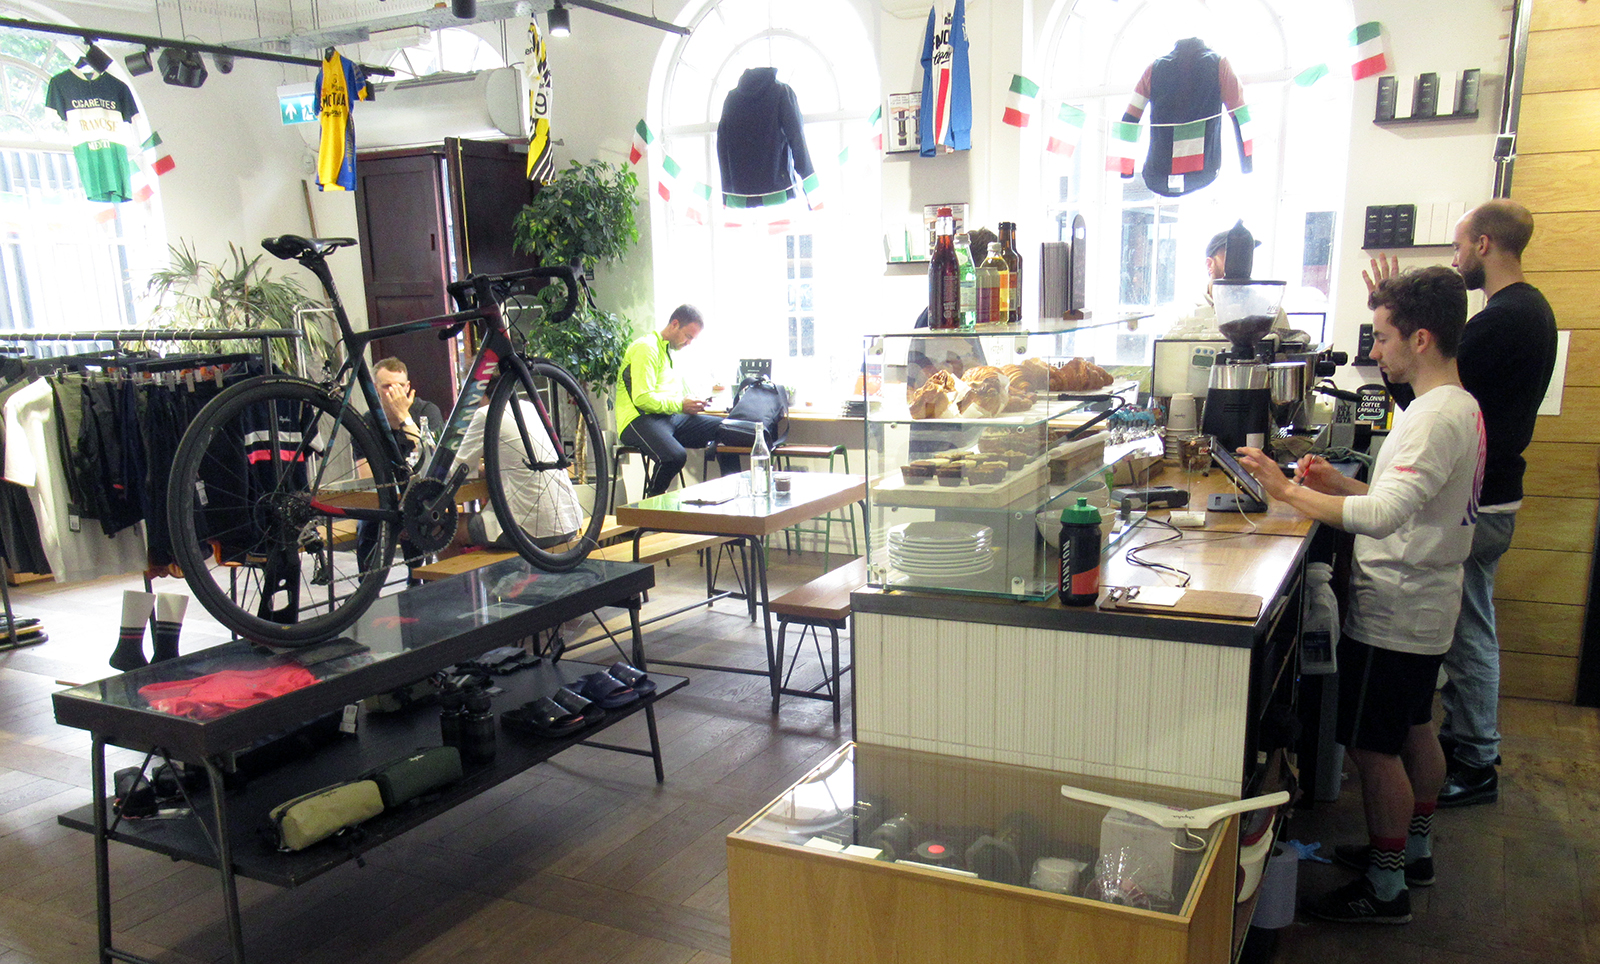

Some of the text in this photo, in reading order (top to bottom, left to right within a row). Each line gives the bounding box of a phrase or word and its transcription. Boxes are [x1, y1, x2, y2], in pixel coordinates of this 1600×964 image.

[71, 98, 116, 109] CIGARETTES
[534, 92, 548, 116] 9
[450, 361, 499, 451] CANYON
[1062, 539, 1071, 592] CANYON
